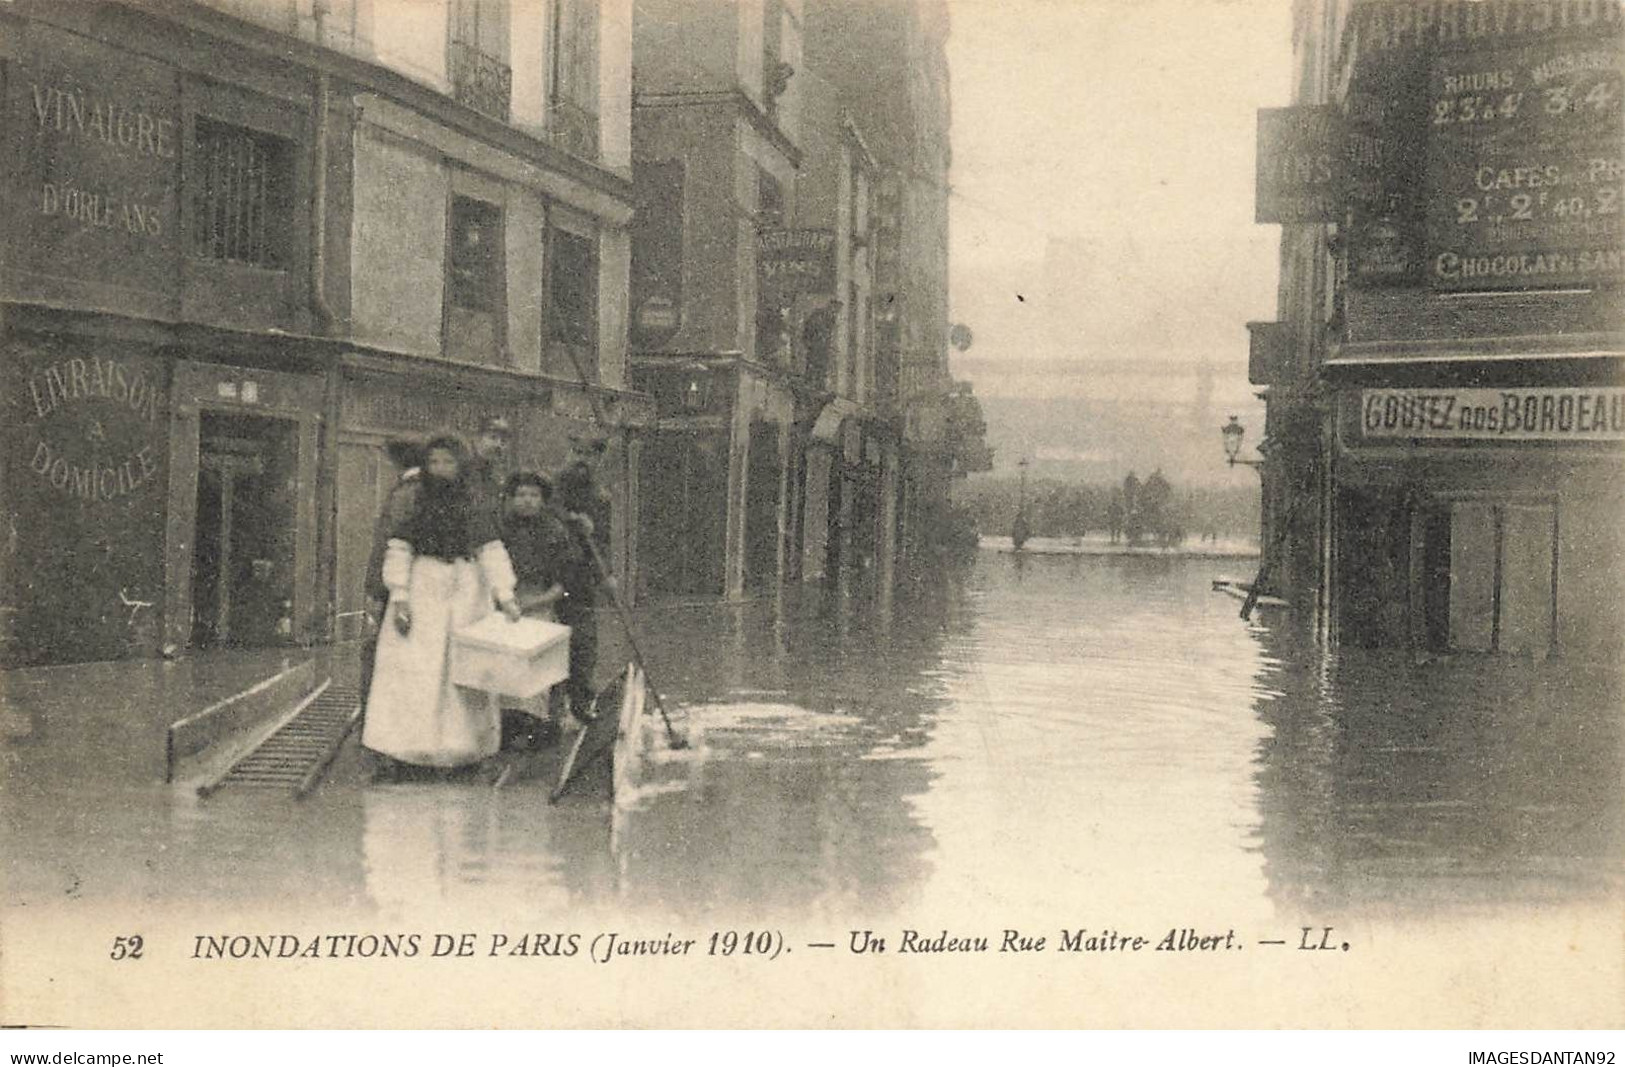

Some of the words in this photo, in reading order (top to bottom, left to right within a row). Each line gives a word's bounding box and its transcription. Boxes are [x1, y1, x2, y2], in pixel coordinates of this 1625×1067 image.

[1443, 69, 1513, 95] RHUMS
[30, 82, 175, 158] VINAIGRE
[30, 355, 155, 420] LIVRAISON
[1365, 395, 1455, 431] GOUTEZ
[1459, 405, 1499, 432] nos
[31, 442, 156, 500] DOMICILE
